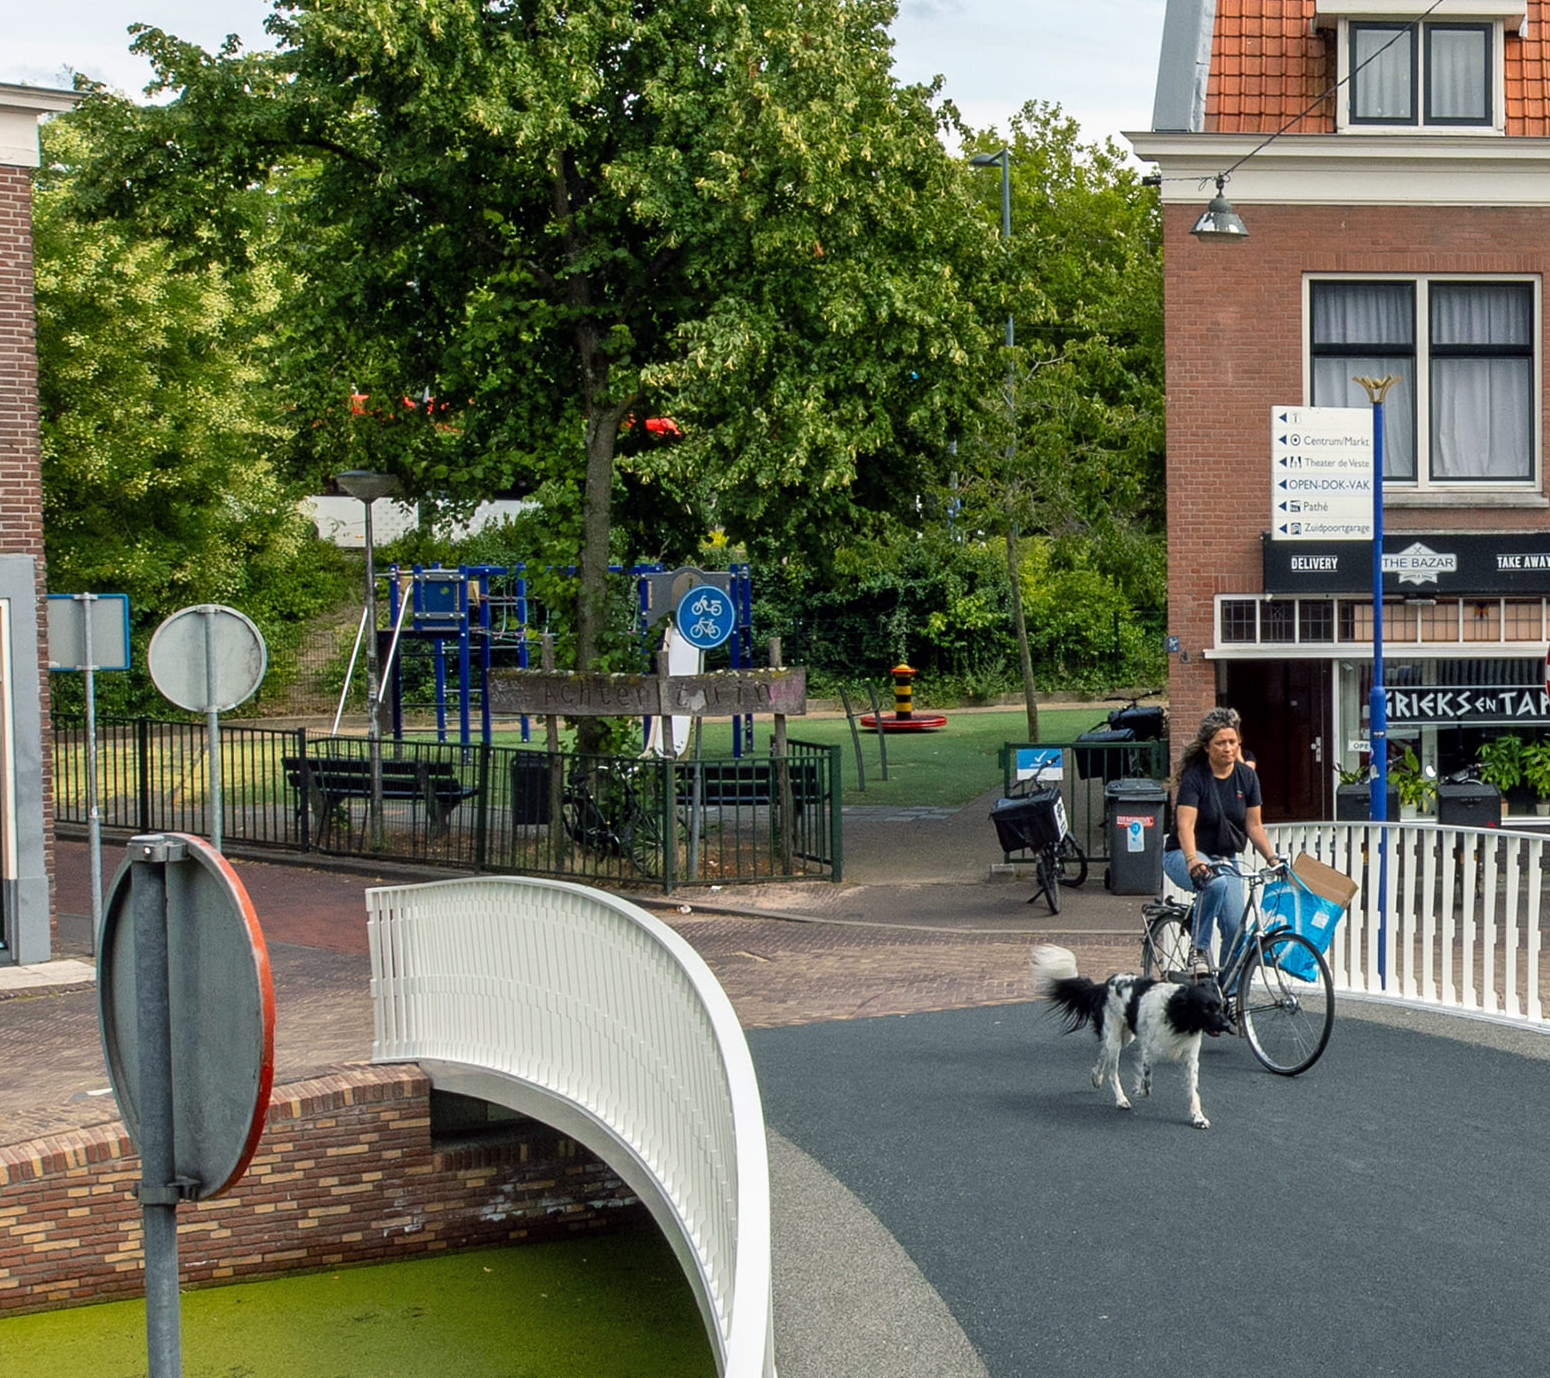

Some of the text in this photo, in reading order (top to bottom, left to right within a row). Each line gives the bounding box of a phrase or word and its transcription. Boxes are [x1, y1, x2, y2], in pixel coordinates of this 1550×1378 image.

[1303, 435, 1370, 447] Centrum/Markt
[1305, 457, 1370, 468] Theater de Veste
[1288, 479, 1370, 490] OPEN-DOK-VAK
[1303, 501, 1329, 512] Pathé
[1304, 523, 1370, 534] Zuidpoortgarage
[1291, 557, 1338, 569] DELIVERY
[1383, 557, 1454, 568] THE BAZAR
[1497, 556, 1521, 569] TAKE
[1353, 742, 1370, 750] OPE
